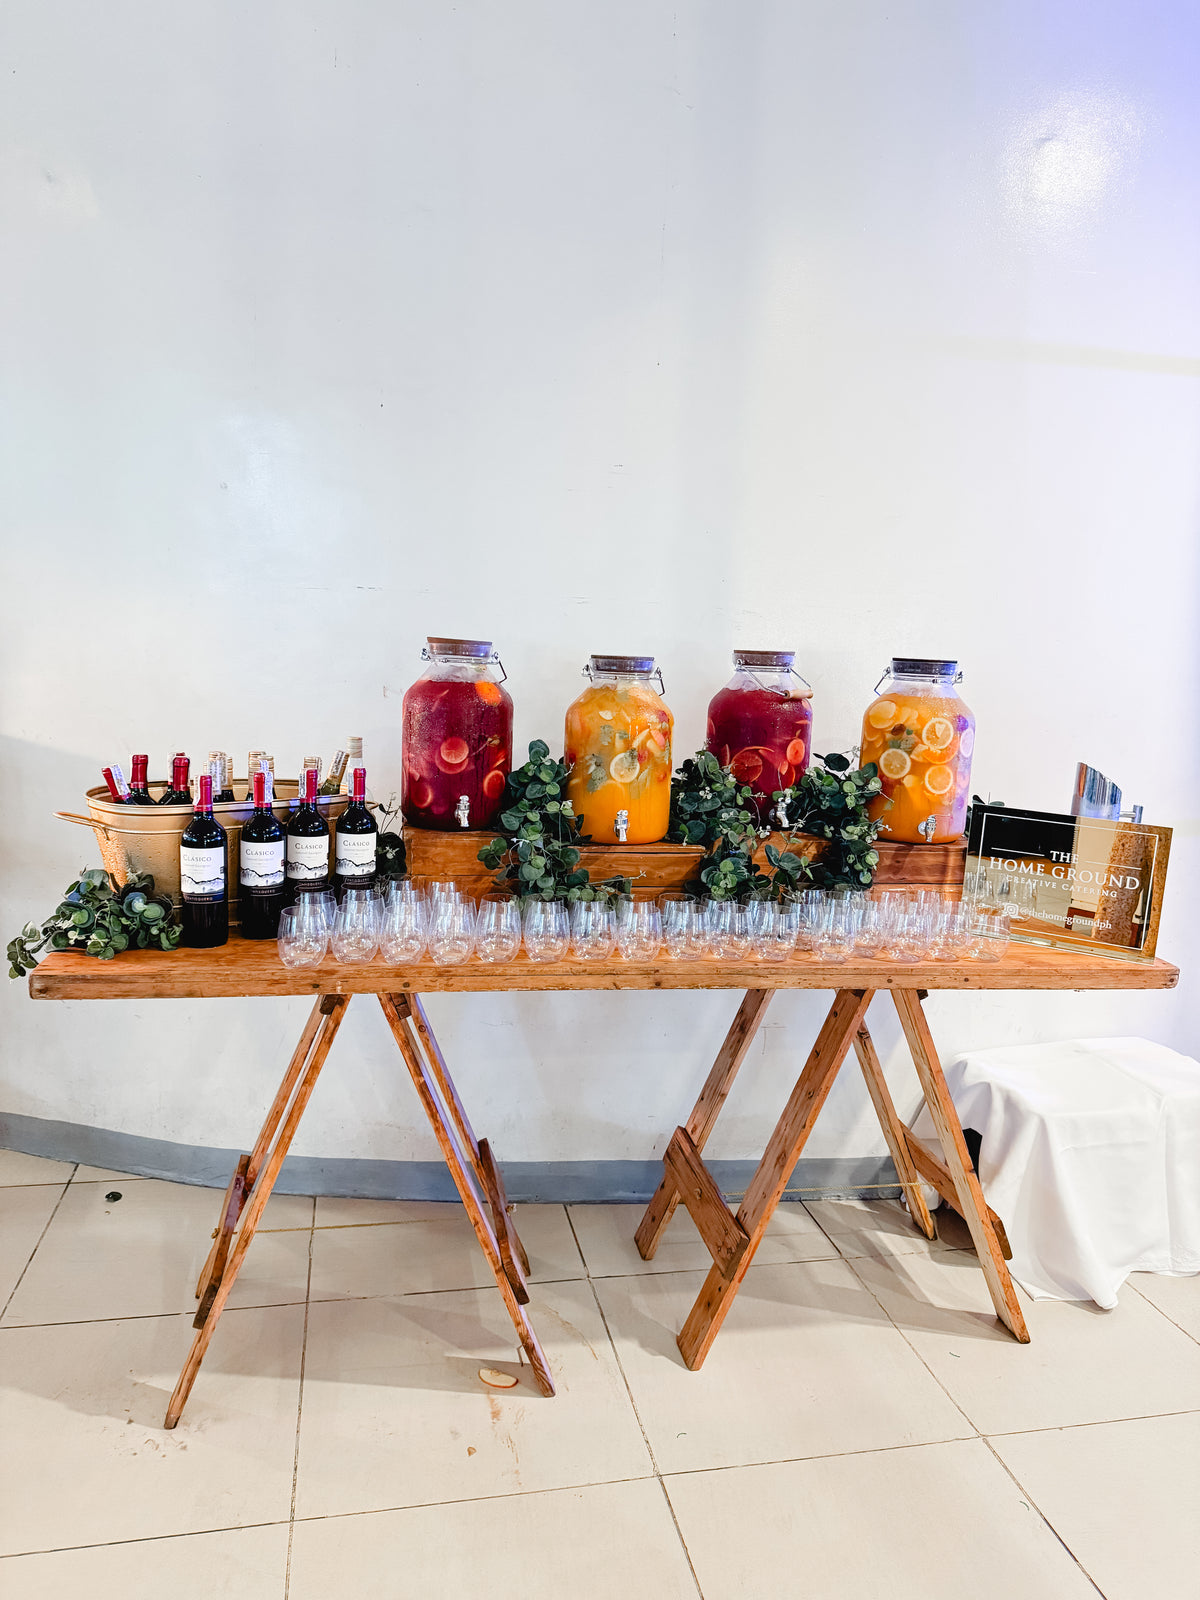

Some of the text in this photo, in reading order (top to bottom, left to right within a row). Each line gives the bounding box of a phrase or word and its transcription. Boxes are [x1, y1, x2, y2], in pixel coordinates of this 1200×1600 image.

[1050, 851, 1080, 864] THE
[990, 857, 1140, 890] HOME GROUND
[1006, 875, 1118, 898] CREATIVE CATERING
[1020, 908, 1112, 930] @thehomegroundph
